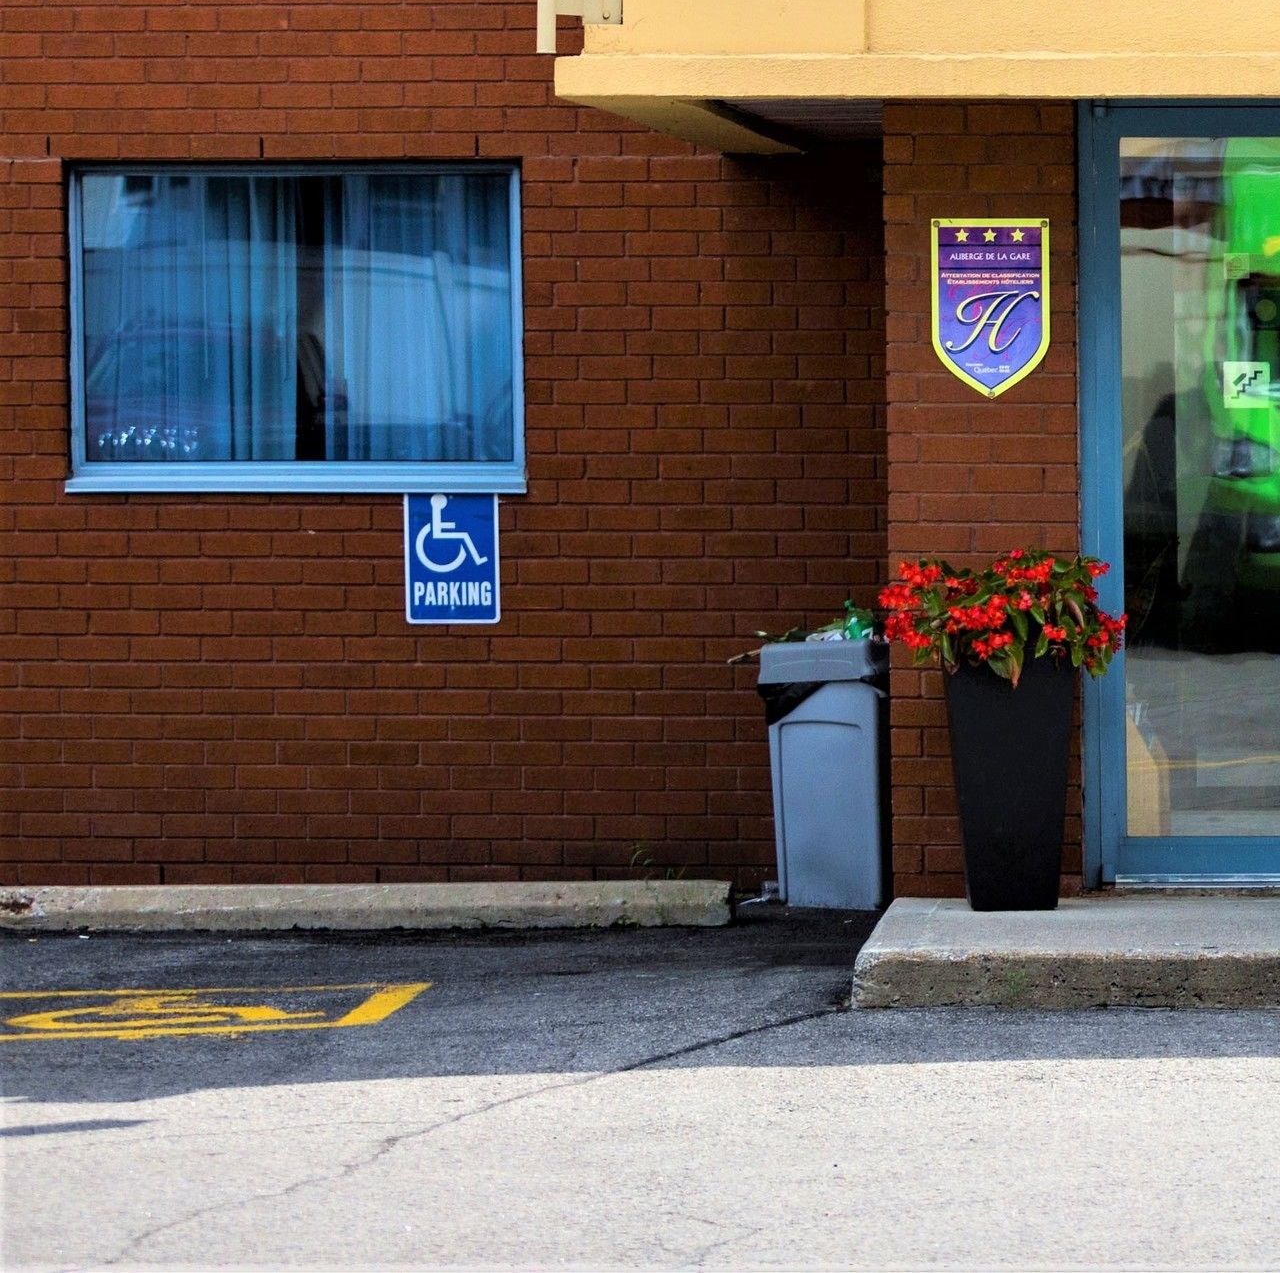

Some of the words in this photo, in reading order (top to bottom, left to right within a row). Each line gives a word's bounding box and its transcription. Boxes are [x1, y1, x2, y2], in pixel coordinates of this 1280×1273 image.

[950, 252, 984, 261] AUBERGE
[985, 252, 995, 261] DE
[997, 252, 1008, 261] LA
[1009, 252, 1031, 261] GARE
[413, 581, 492, 606] PARKING
